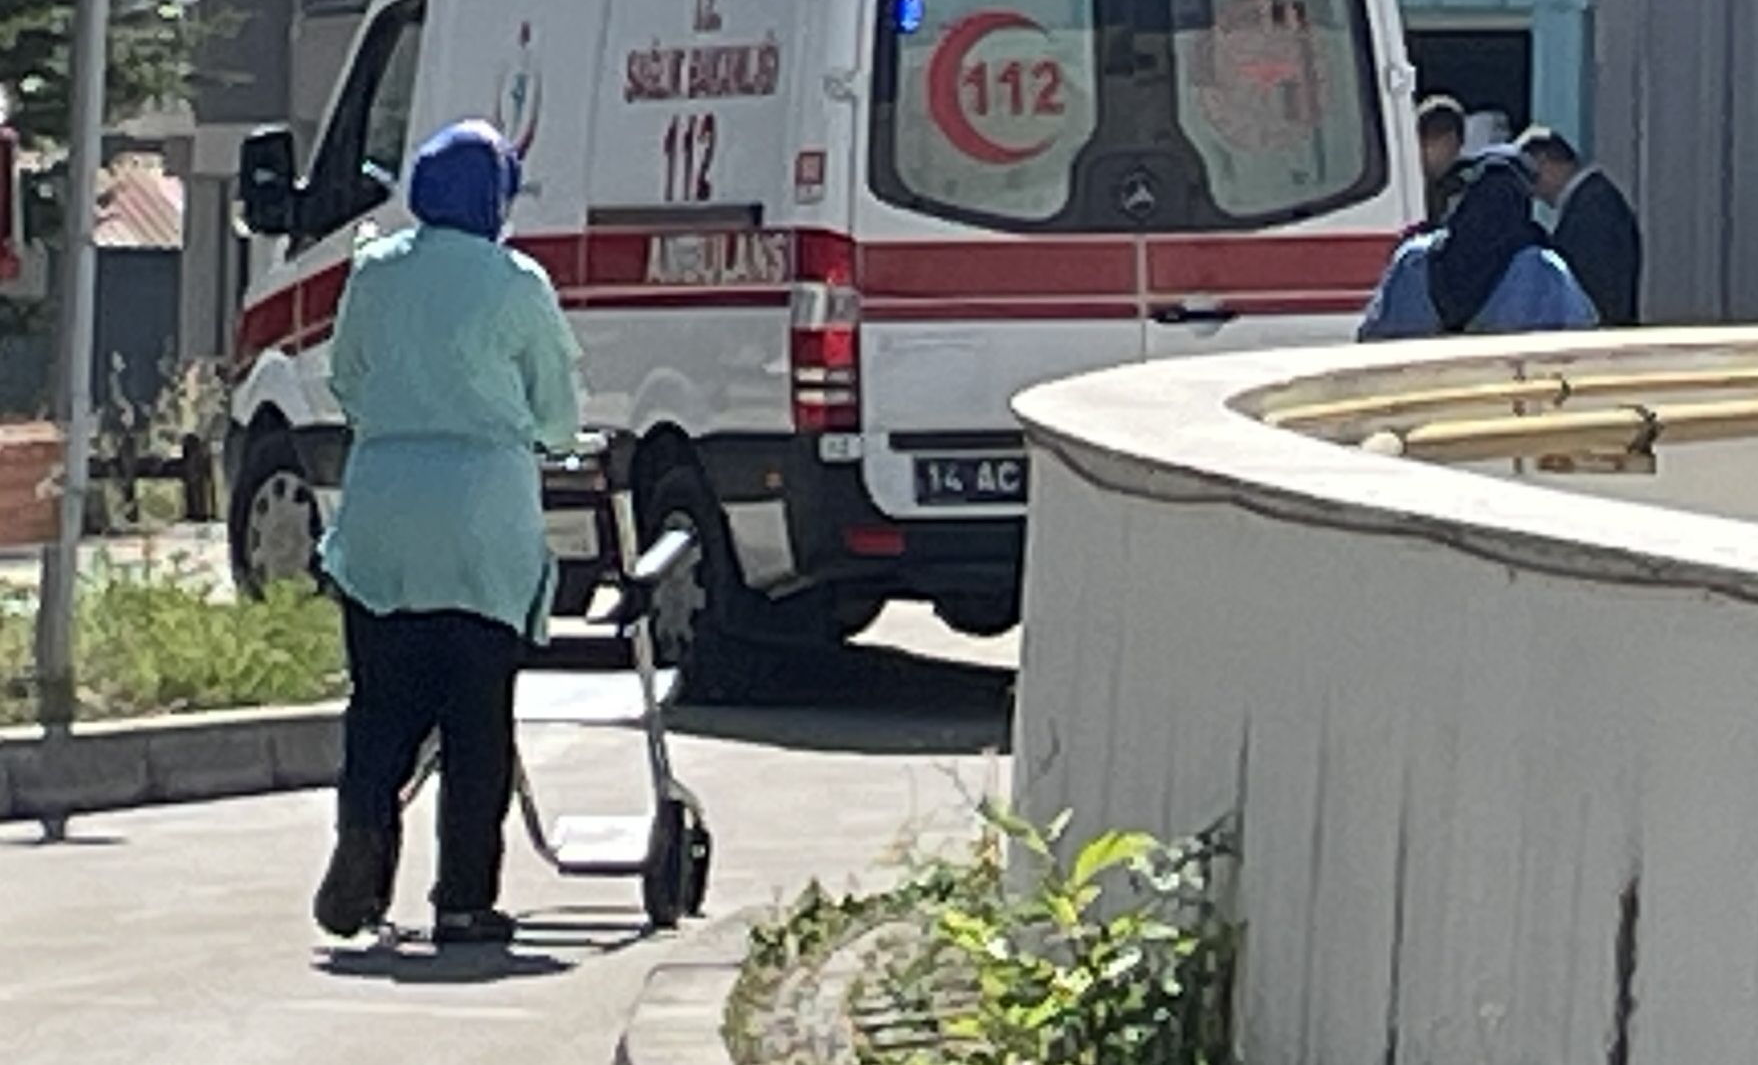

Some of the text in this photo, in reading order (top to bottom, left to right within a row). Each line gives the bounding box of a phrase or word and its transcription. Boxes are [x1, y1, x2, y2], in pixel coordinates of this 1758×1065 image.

[962, 59, 1065, 118] 112
[663, 112, 716, 202] 112
[928, 460, 964, 492] 14
